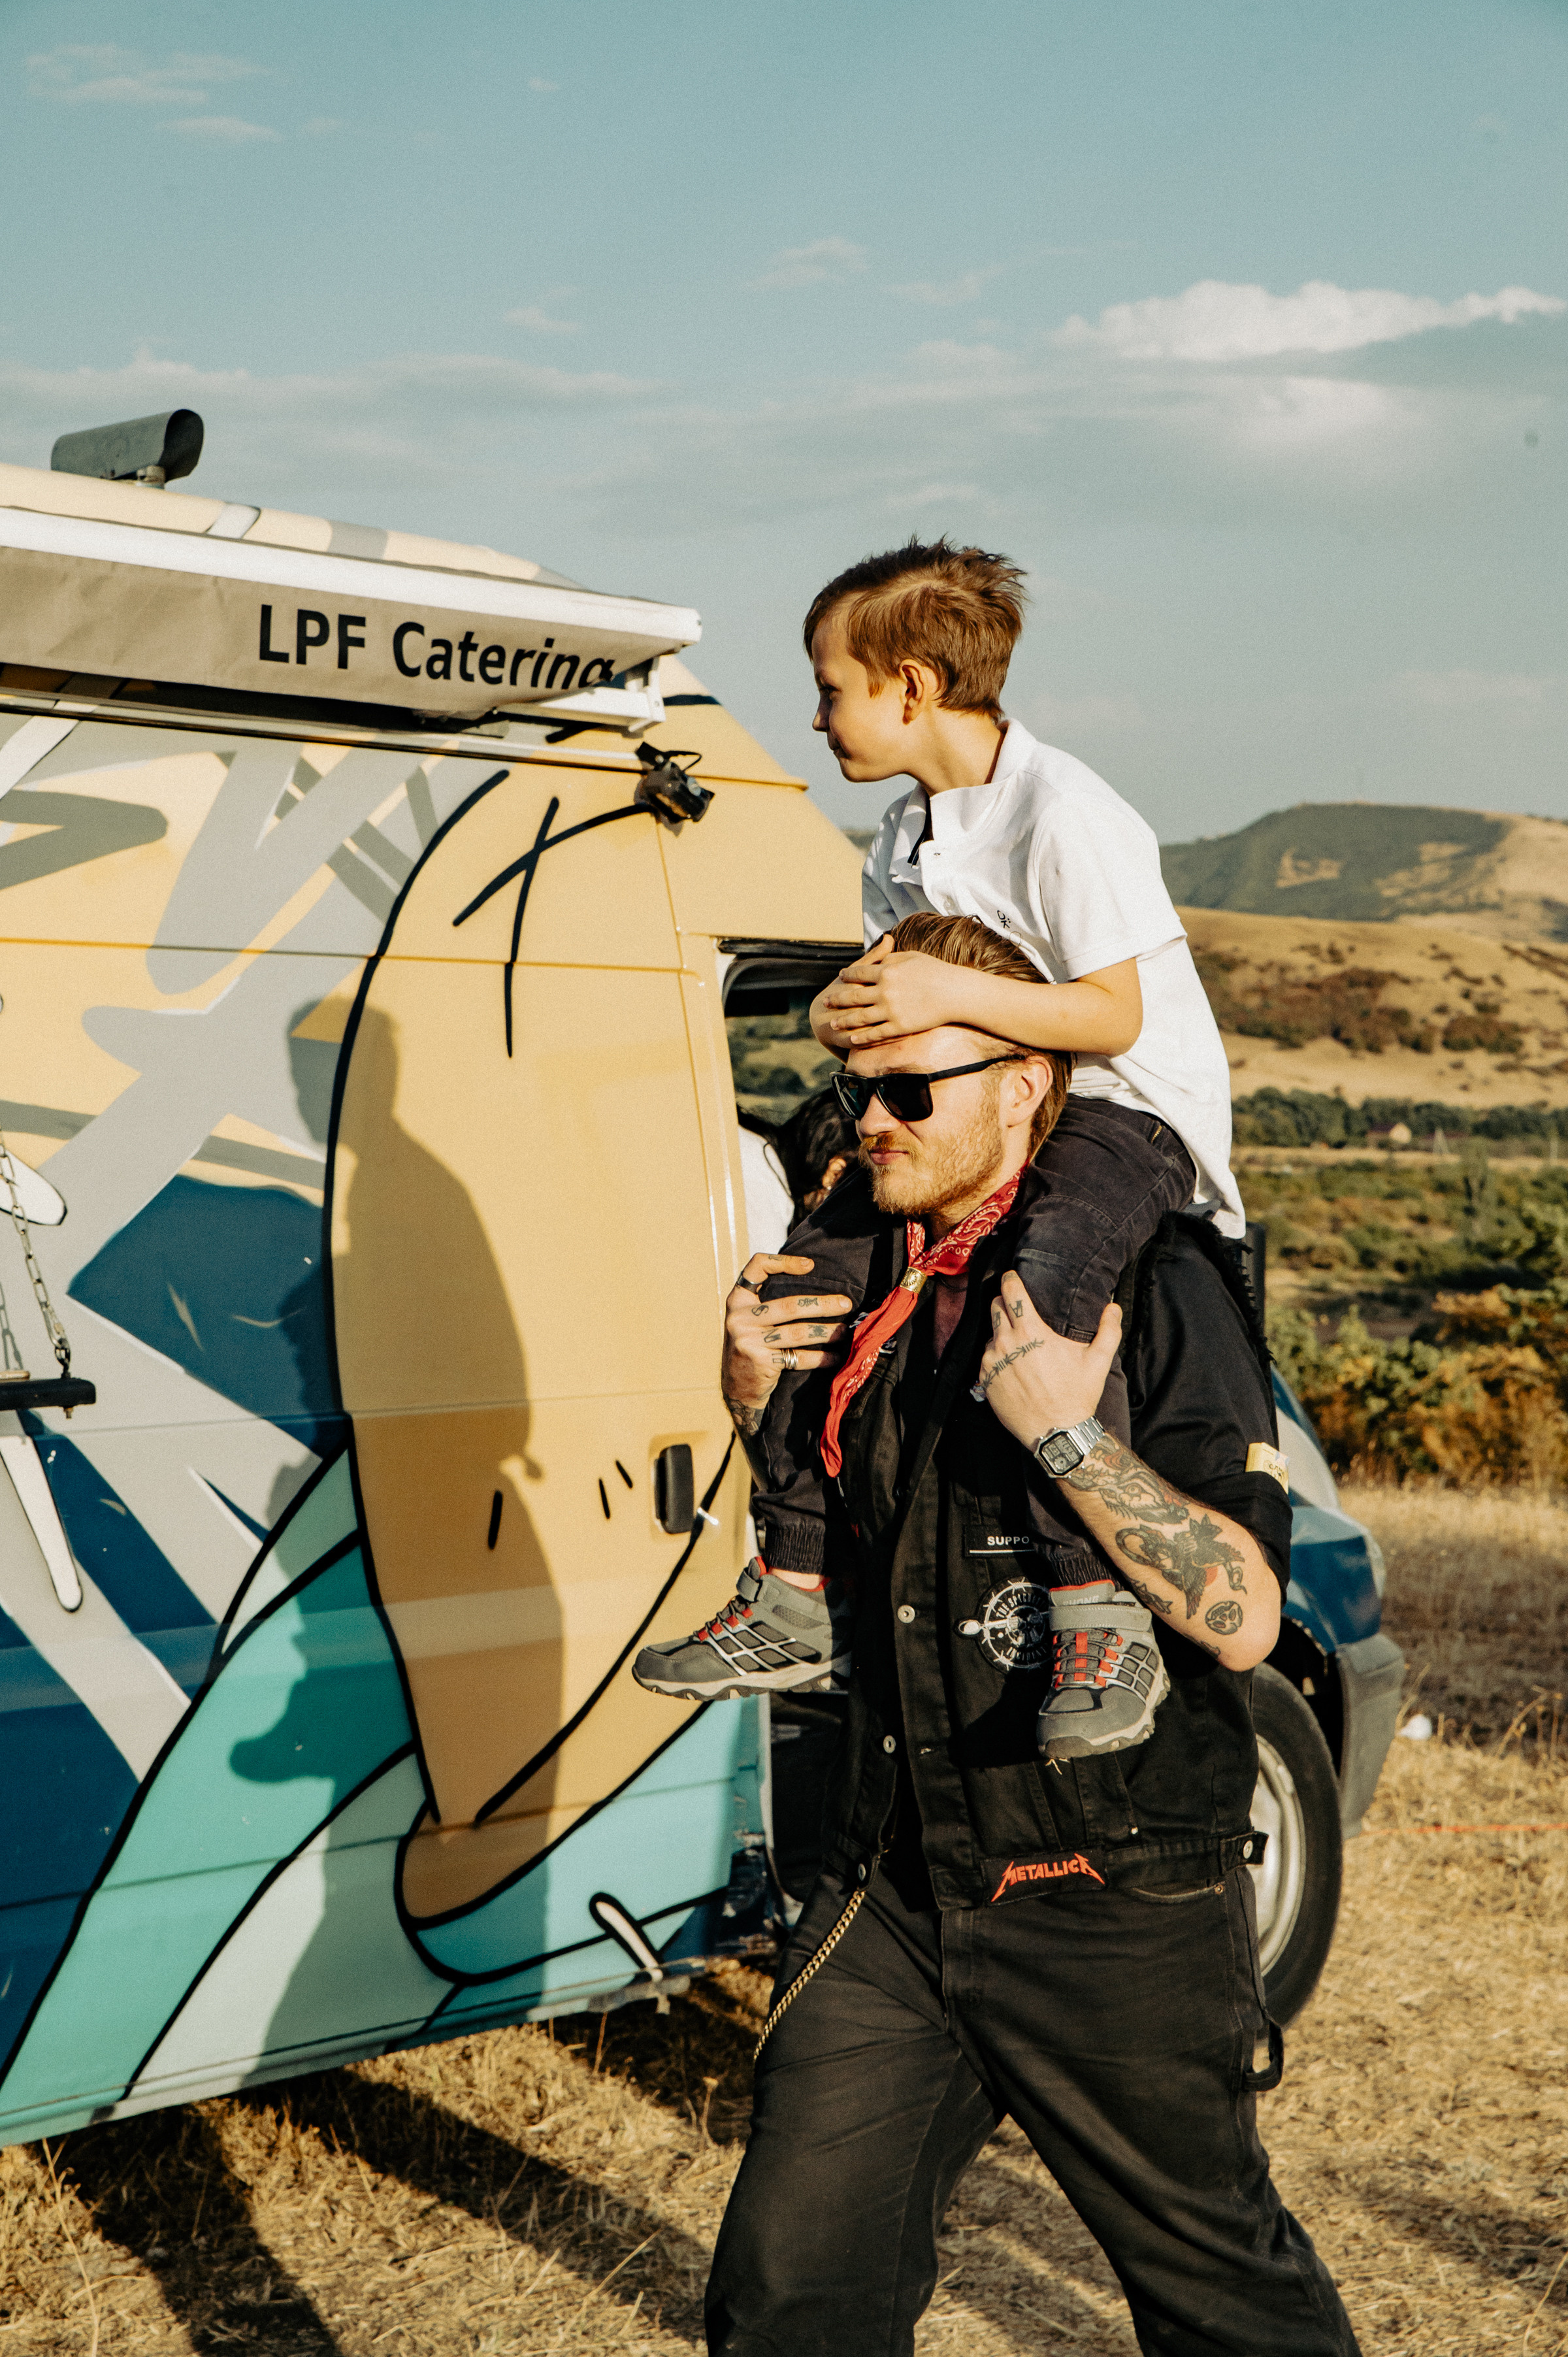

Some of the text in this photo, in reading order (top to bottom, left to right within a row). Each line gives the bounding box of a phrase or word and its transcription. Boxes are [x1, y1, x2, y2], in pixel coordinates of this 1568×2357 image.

[259, 604, 367, 669] LPF
[987, 1536, 1030, 1547] SUPPO
[996, 1603, 1010, 1619] THE
[990, 1853, 1105, 1902] METALLICA
